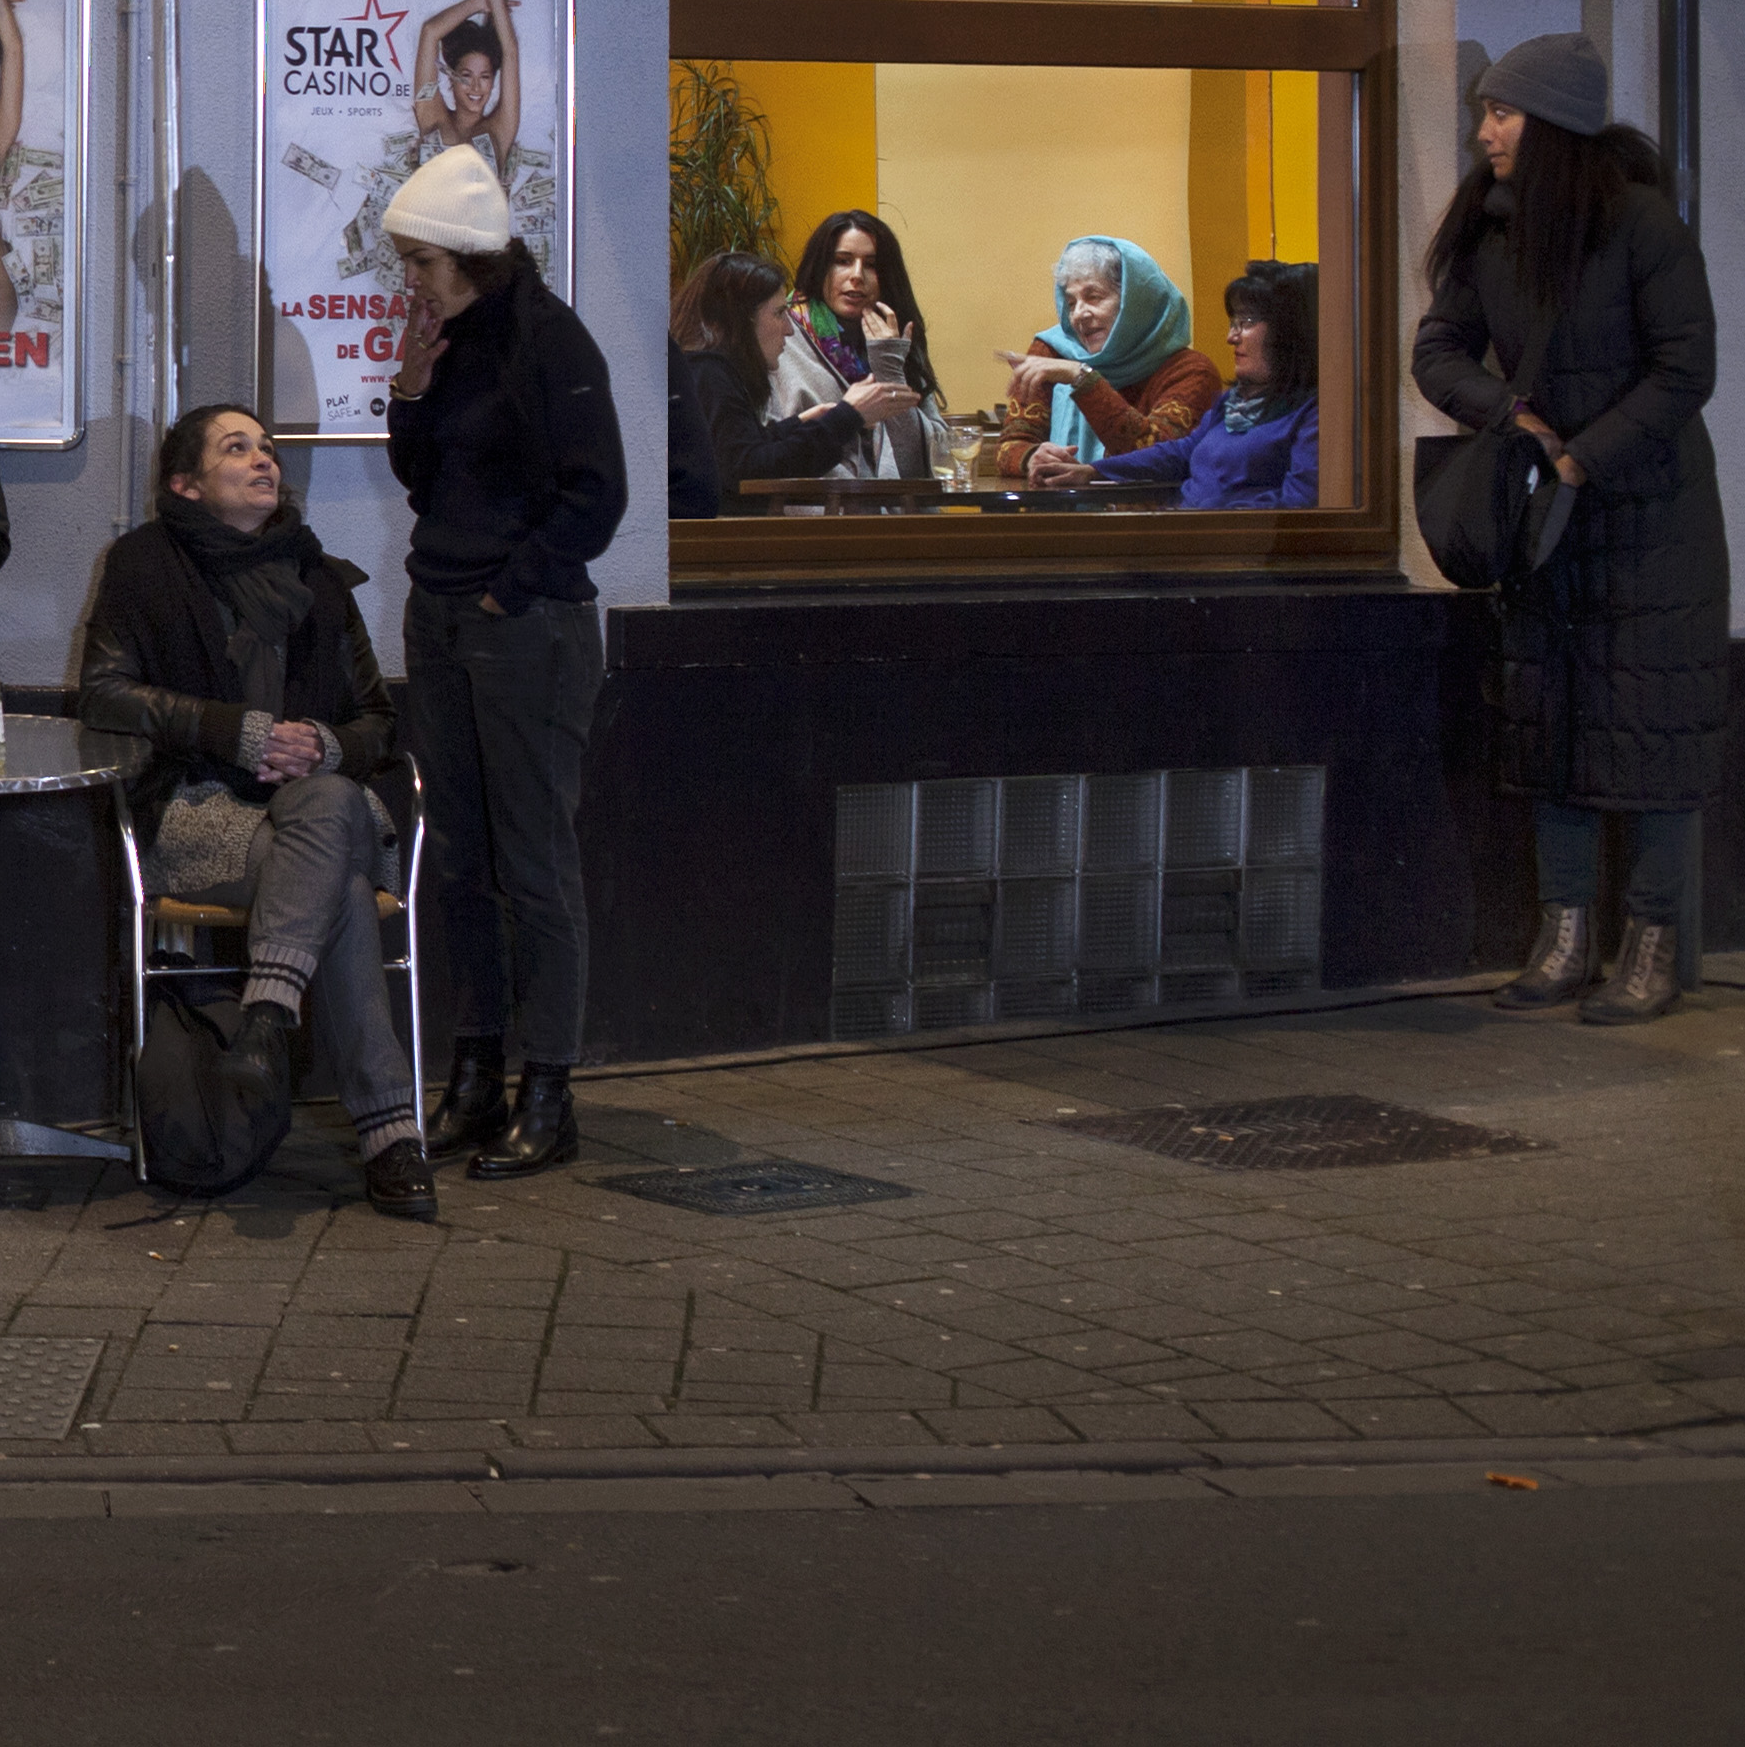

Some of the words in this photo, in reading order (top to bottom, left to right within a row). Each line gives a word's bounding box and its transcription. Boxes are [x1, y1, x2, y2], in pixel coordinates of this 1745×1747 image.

[284, 26, 384, 68] STAR
[311, 107, 334, 116] JEUX
[347, 107, 383, 117] SPORTS
[281, 302, 304, 316] LA
[308, 294, 413, 320] SENSA
[337, 344, 360, 359] DE
[326, 394, 349, 408] PLAY
